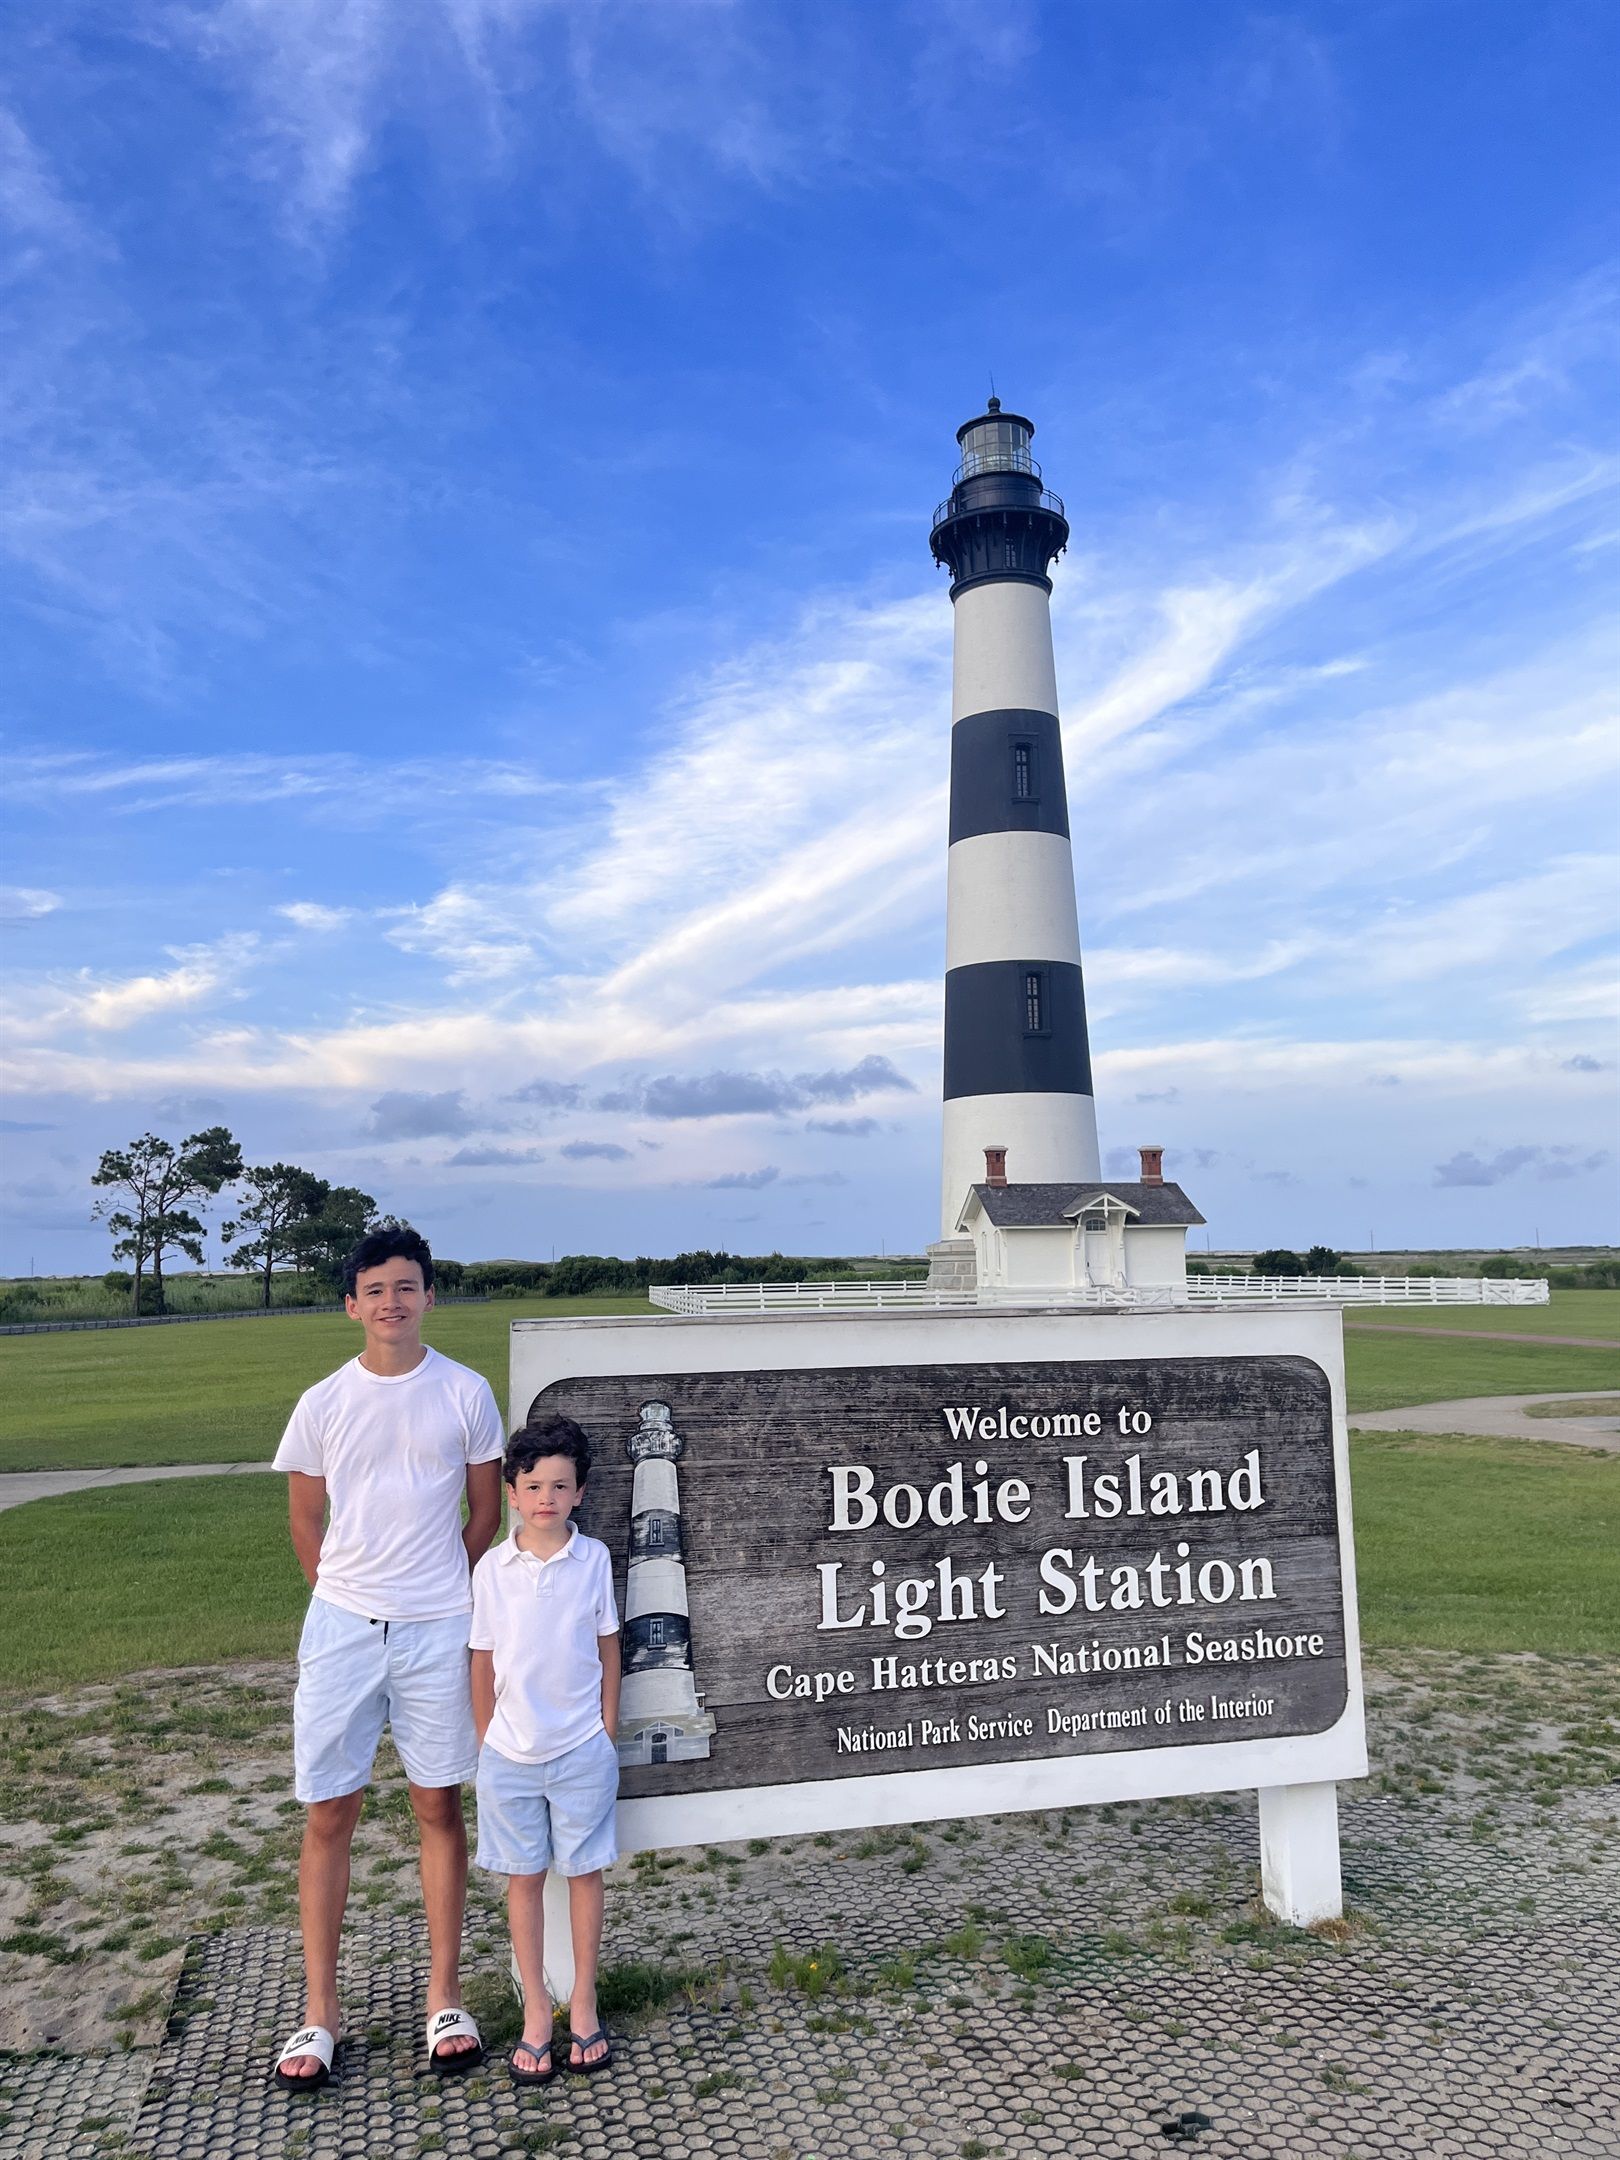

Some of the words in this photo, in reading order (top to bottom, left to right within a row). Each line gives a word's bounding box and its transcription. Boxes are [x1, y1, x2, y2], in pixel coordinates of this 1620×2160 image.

[942, 1406, 1101, 1441] Welcome
[1117, 1405, 1152, 1435] to
[827, 1460, 1031, 1531] Bodie
[1062, 1448, 1266, 1519] Island
[816, 1556, 1006, 1640] Light
[1039, 1542, 1277, 1615] Station
[766, 1664, 855, 1703] Cape
[871, 1656, 1017, 1690] Hatteras
[1031, 1635, 1172, 1676] National
[1185, 1628, 1324, 1664] Seashore
[837, 1722, 914, 1753] National
[921, 1718, 961, 1745] Park
[968, 1715, 1033, 1741] Service
[1047, 1705, 1148, 1737] Department
[1154, 1699, 1172, 1725] of
[1178, 1698, 1205, 1723] the
[1211, 1695, 1275, 1720] Interior
[438, 2013, 462, 2025] NIKE
